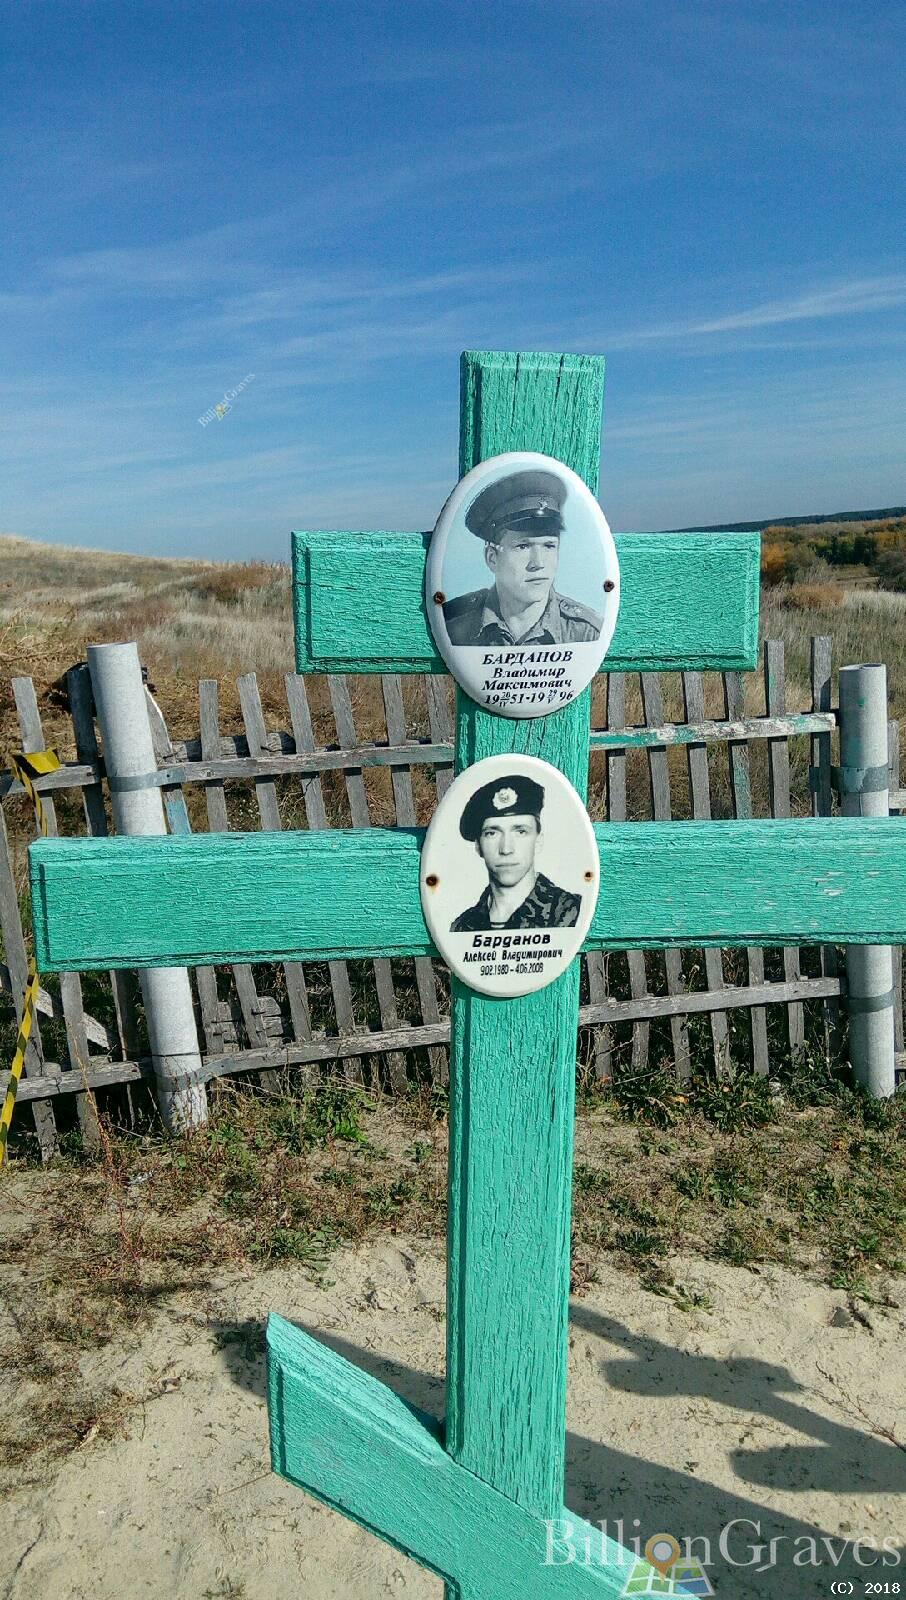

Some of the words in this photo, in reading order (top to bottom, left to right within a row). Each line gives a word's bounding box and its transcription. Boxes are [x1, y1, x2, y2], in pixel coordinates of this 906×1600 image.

[482, 650, 573, 666] БАРДАНОВ
[491, 666, 566, 678] Владимир
[481, 679, 572, 691] Максимович
[472, 934, 551, 948] Барданов
[463, 951, 497, 962] Алексей
[502, 949, 563, 962] Владимирович
